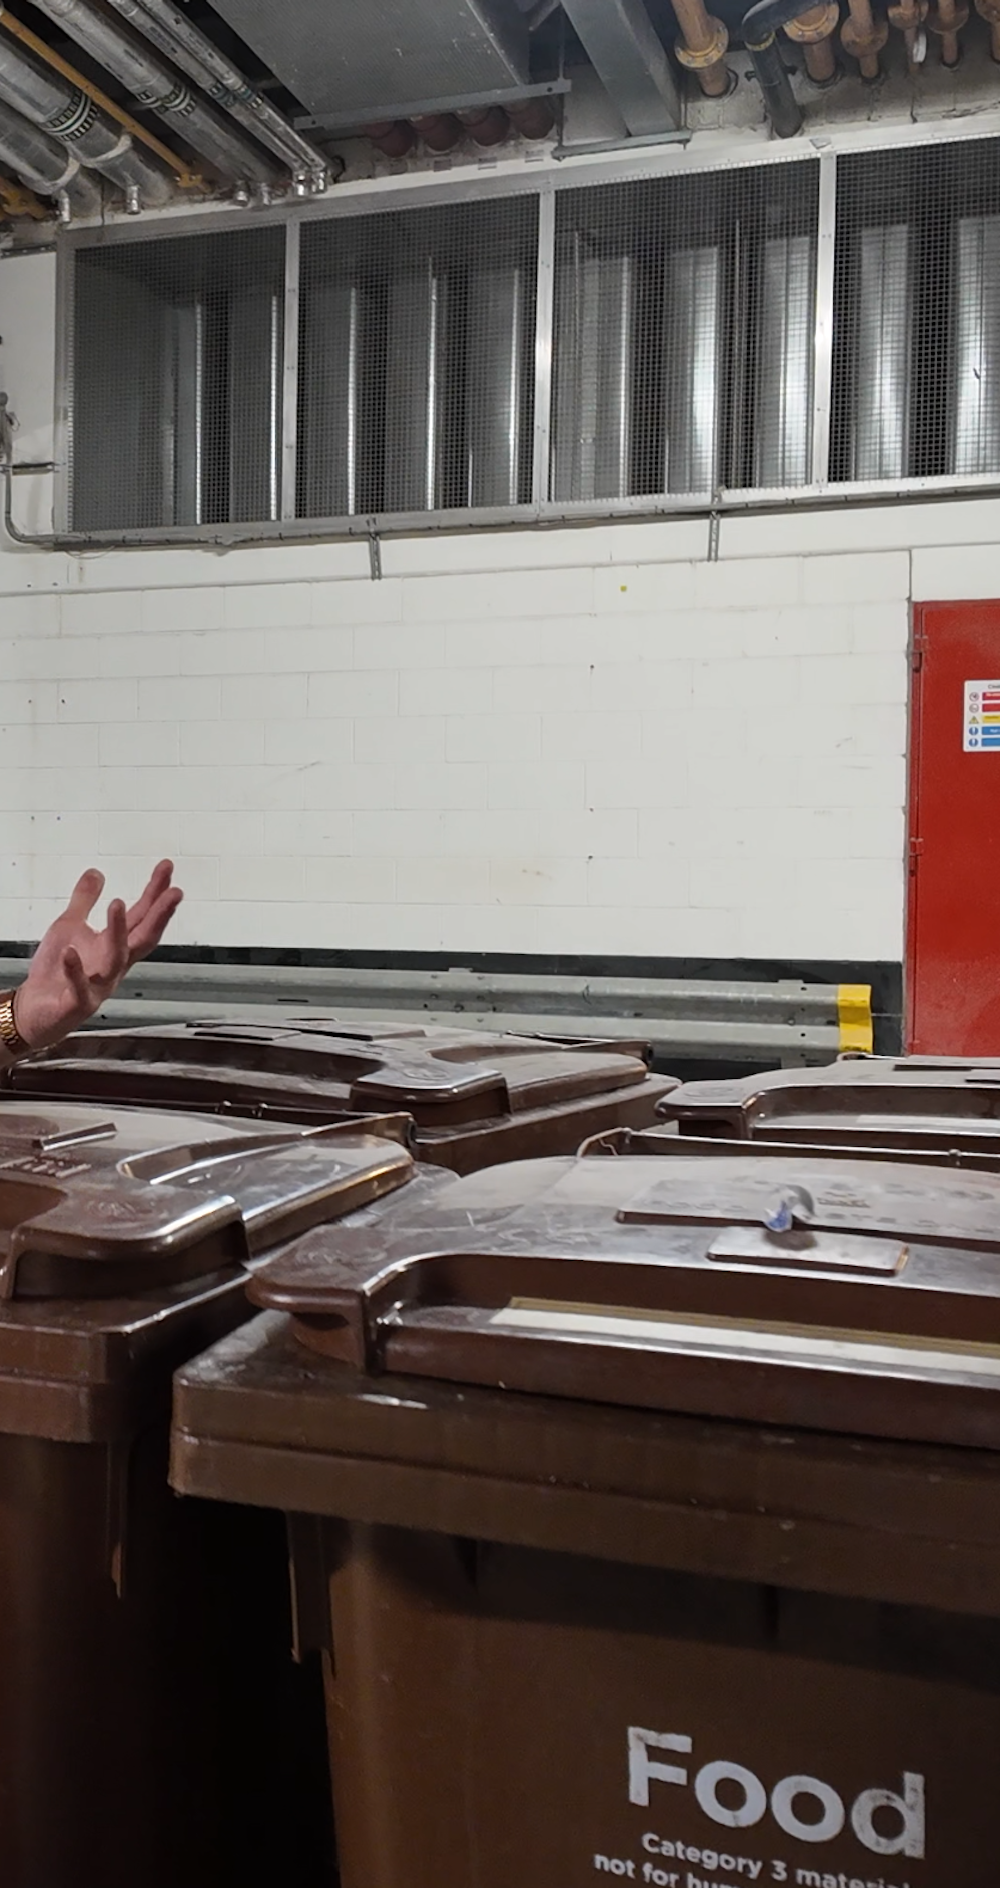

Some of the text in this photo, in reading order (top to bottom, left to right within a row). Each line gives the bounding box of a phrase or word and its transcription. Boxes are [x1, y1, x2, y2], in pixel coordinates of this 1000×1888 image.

[627, 1725, 926, 1860] Food
[593, 1853, 637, 1880] not
[642, 1862, 680, 1888] for
[641, 1831, 764, 1881] Category
[770, 1859, 788, 1882] 3
[795, 1868, 911, 1888] mate
